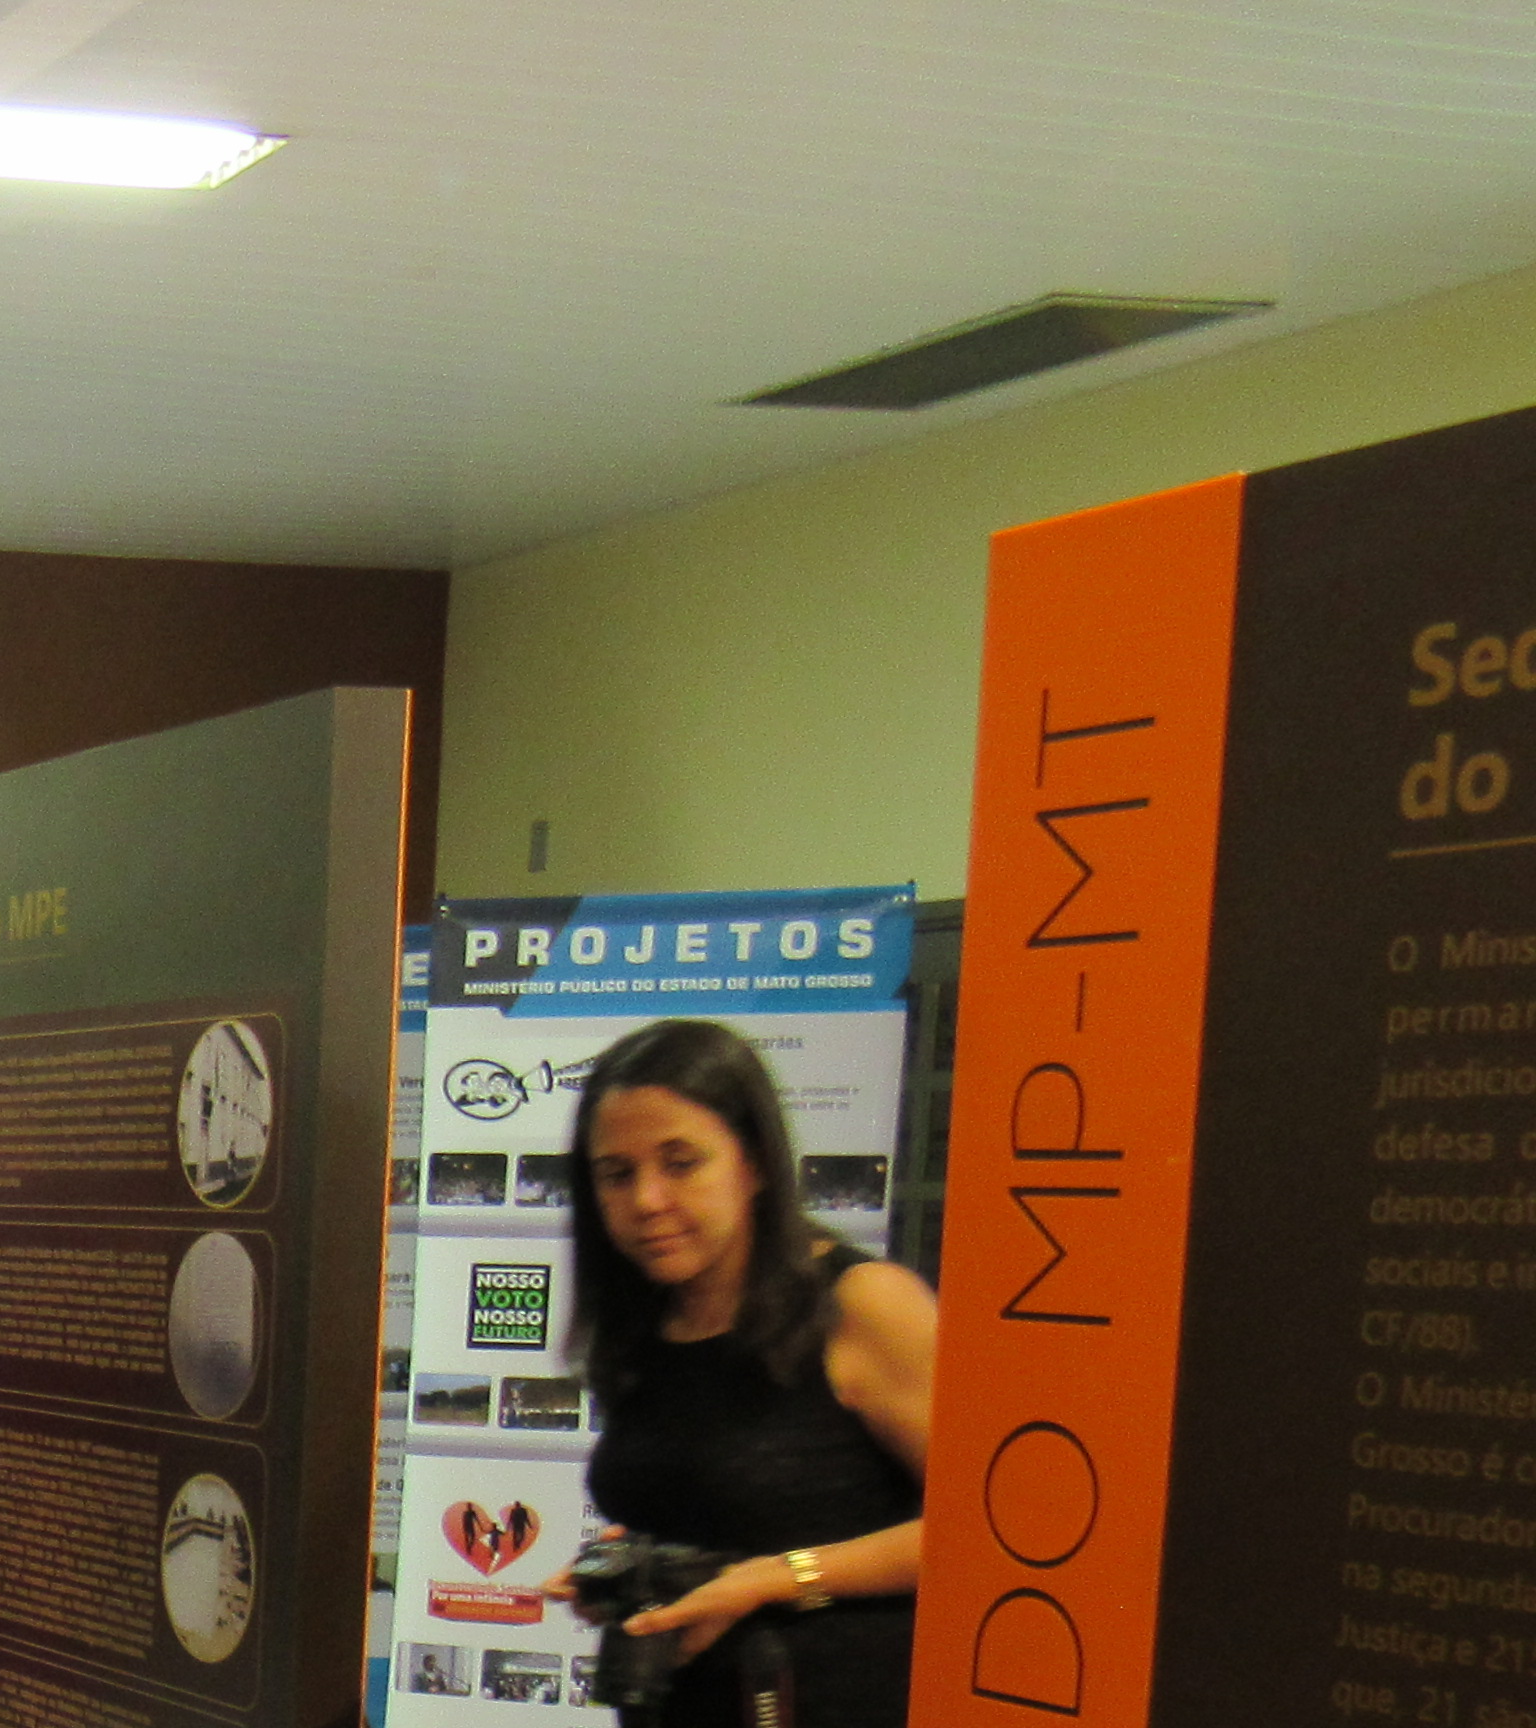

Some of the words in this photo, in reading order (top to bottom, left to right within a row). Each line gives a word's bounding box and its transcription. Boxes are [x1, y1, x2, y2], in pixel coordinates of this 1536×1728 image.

[1400, 734, 1510, 820] do
[7, 888, 69, 941] MPE
[464, 919, 876, 968] PROJETOS
[1387, 933, 1419, 973] O
[631, 978, 655, 992] DO
[659, 976, 722, 991] ESTADO
[726, 975, 750, 990] DE
[753, 975, 800, 990] MATO
[804, 974, 873, 989] GROSSO
[1000, 688, 1156, 1326] MP-MT
[1374, 1122, 1495, 1162] defesa
[476, 1273, 545, 1289] NOSSO
[1364, 1250, 1477, 1288] sociais
[1487, 1261, 1508, 1290] e
[474, 1310, 543, 1326] NOSSO
[475, 1289, 545, 1309] VOTO
[474, 1325, 542, 1338] FUTURO
[1355, 1370, 1384, 1408] O
[1350, 1430, 1471, 1478] Grosso
[1481, 1441, 1505, 1482] é
[971, 1420, 1100, 1718] DO
[1340, 1560, 1381, 1592] na
[1335, 1612, 1447, 1669] Justiça
[1455, 1639, 1477, 1666] e
[1484, 1634, 1525, 1674] 21
[1417, 1685, 1457, 1727] 21
